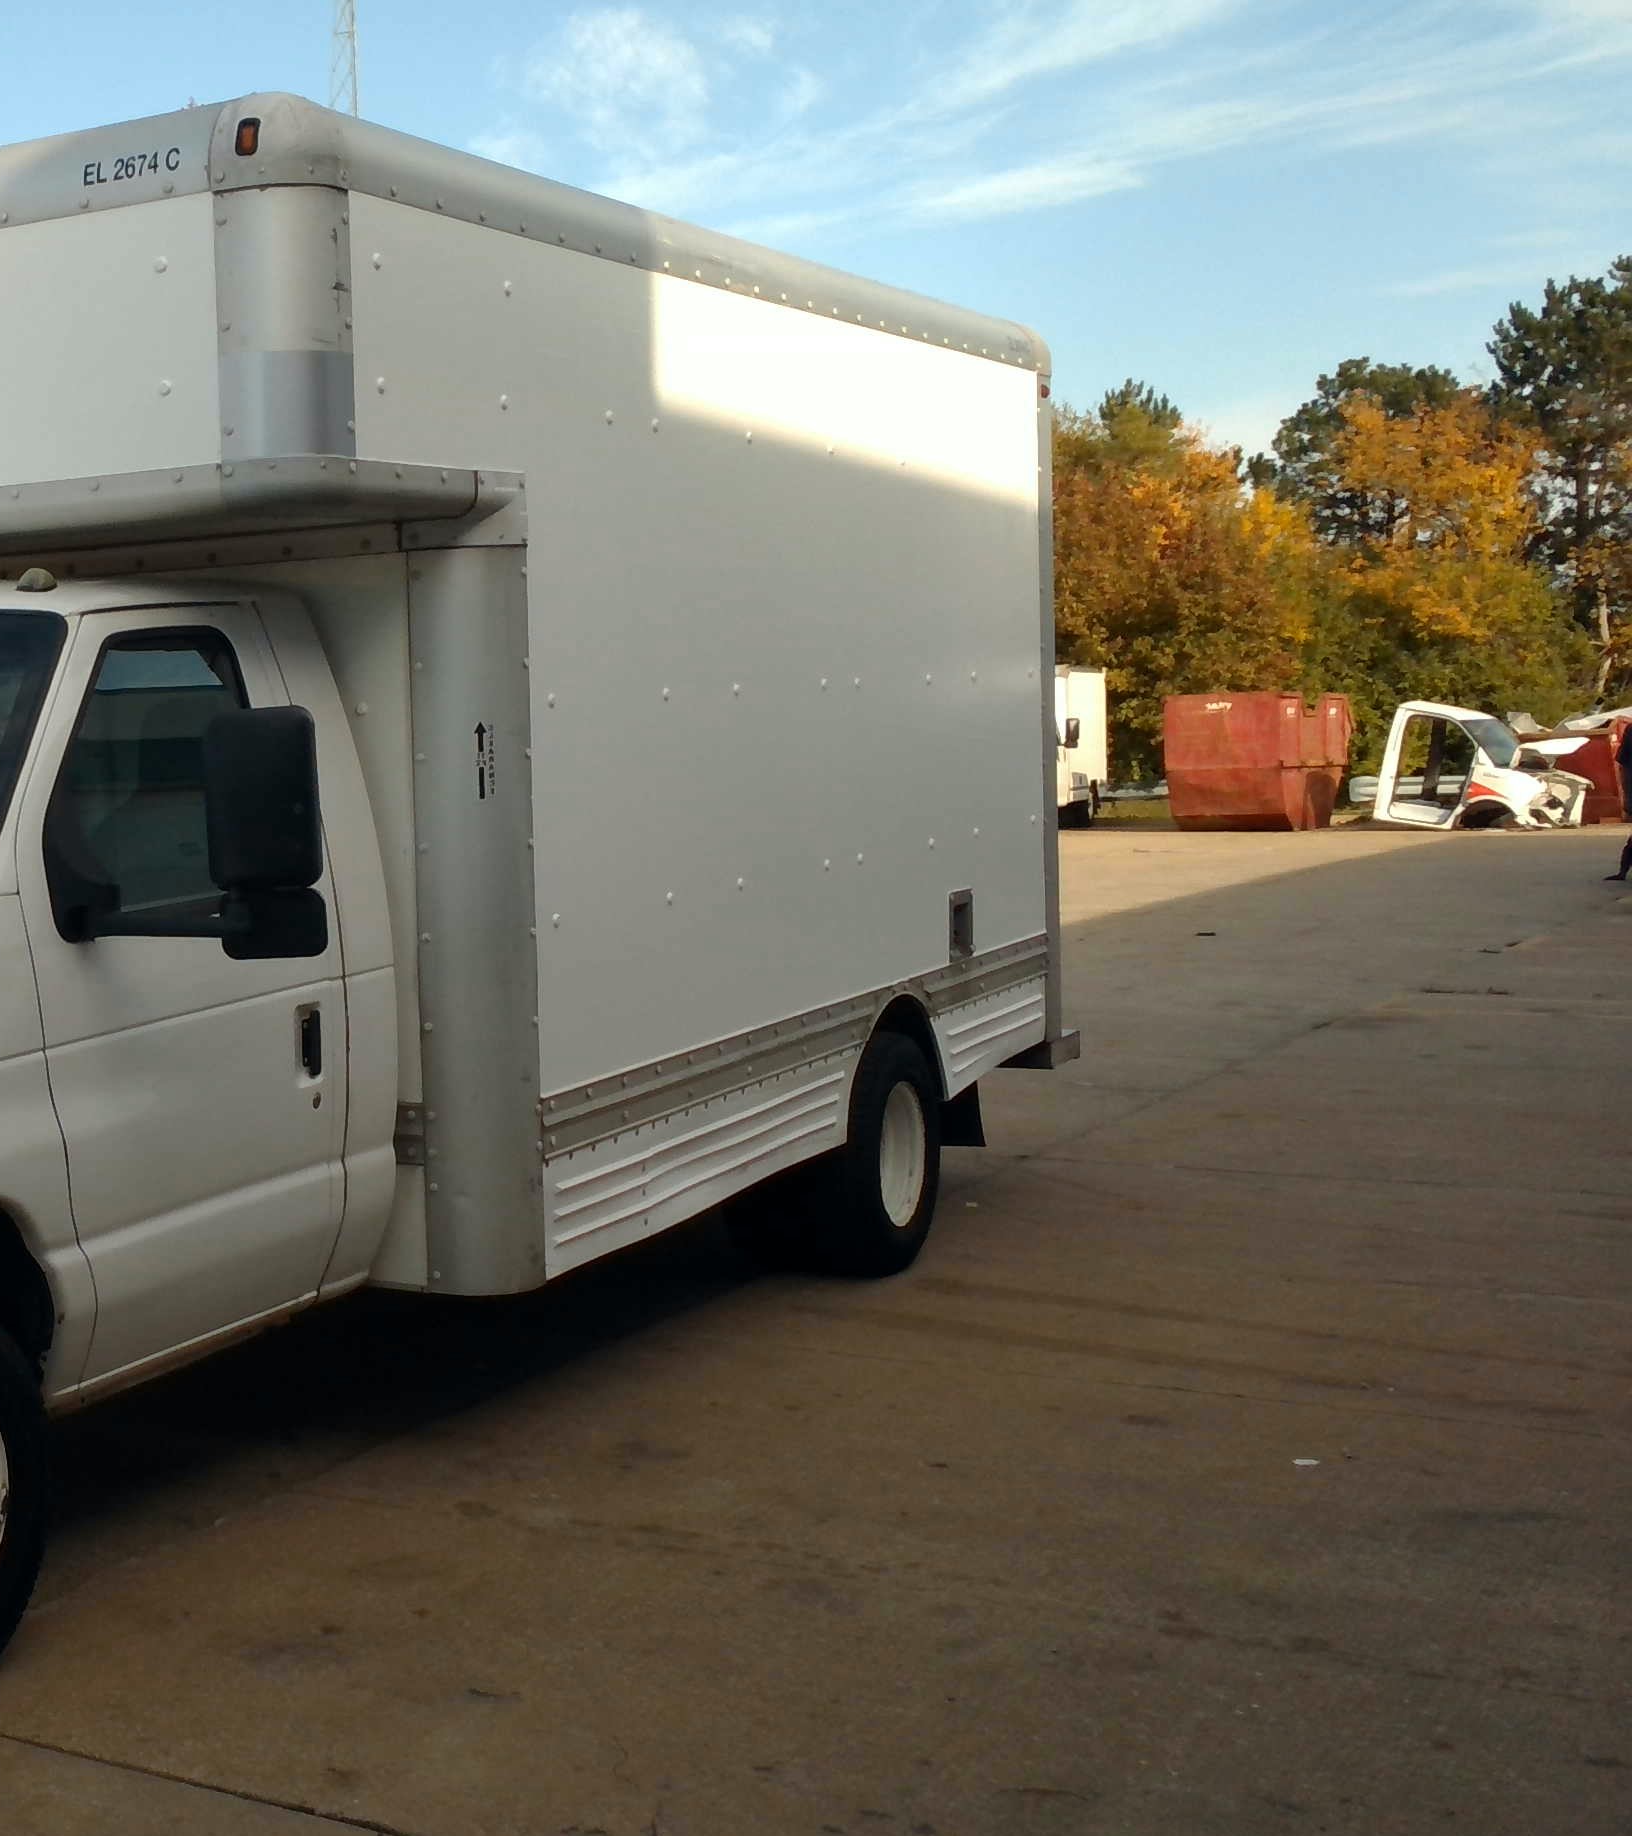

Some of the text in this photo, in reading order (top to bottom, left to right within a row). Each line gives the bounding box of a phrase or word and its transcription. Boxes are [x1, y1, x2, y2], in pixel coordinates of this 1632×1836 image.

[83, 147, 181, 186] EL 2674 C
